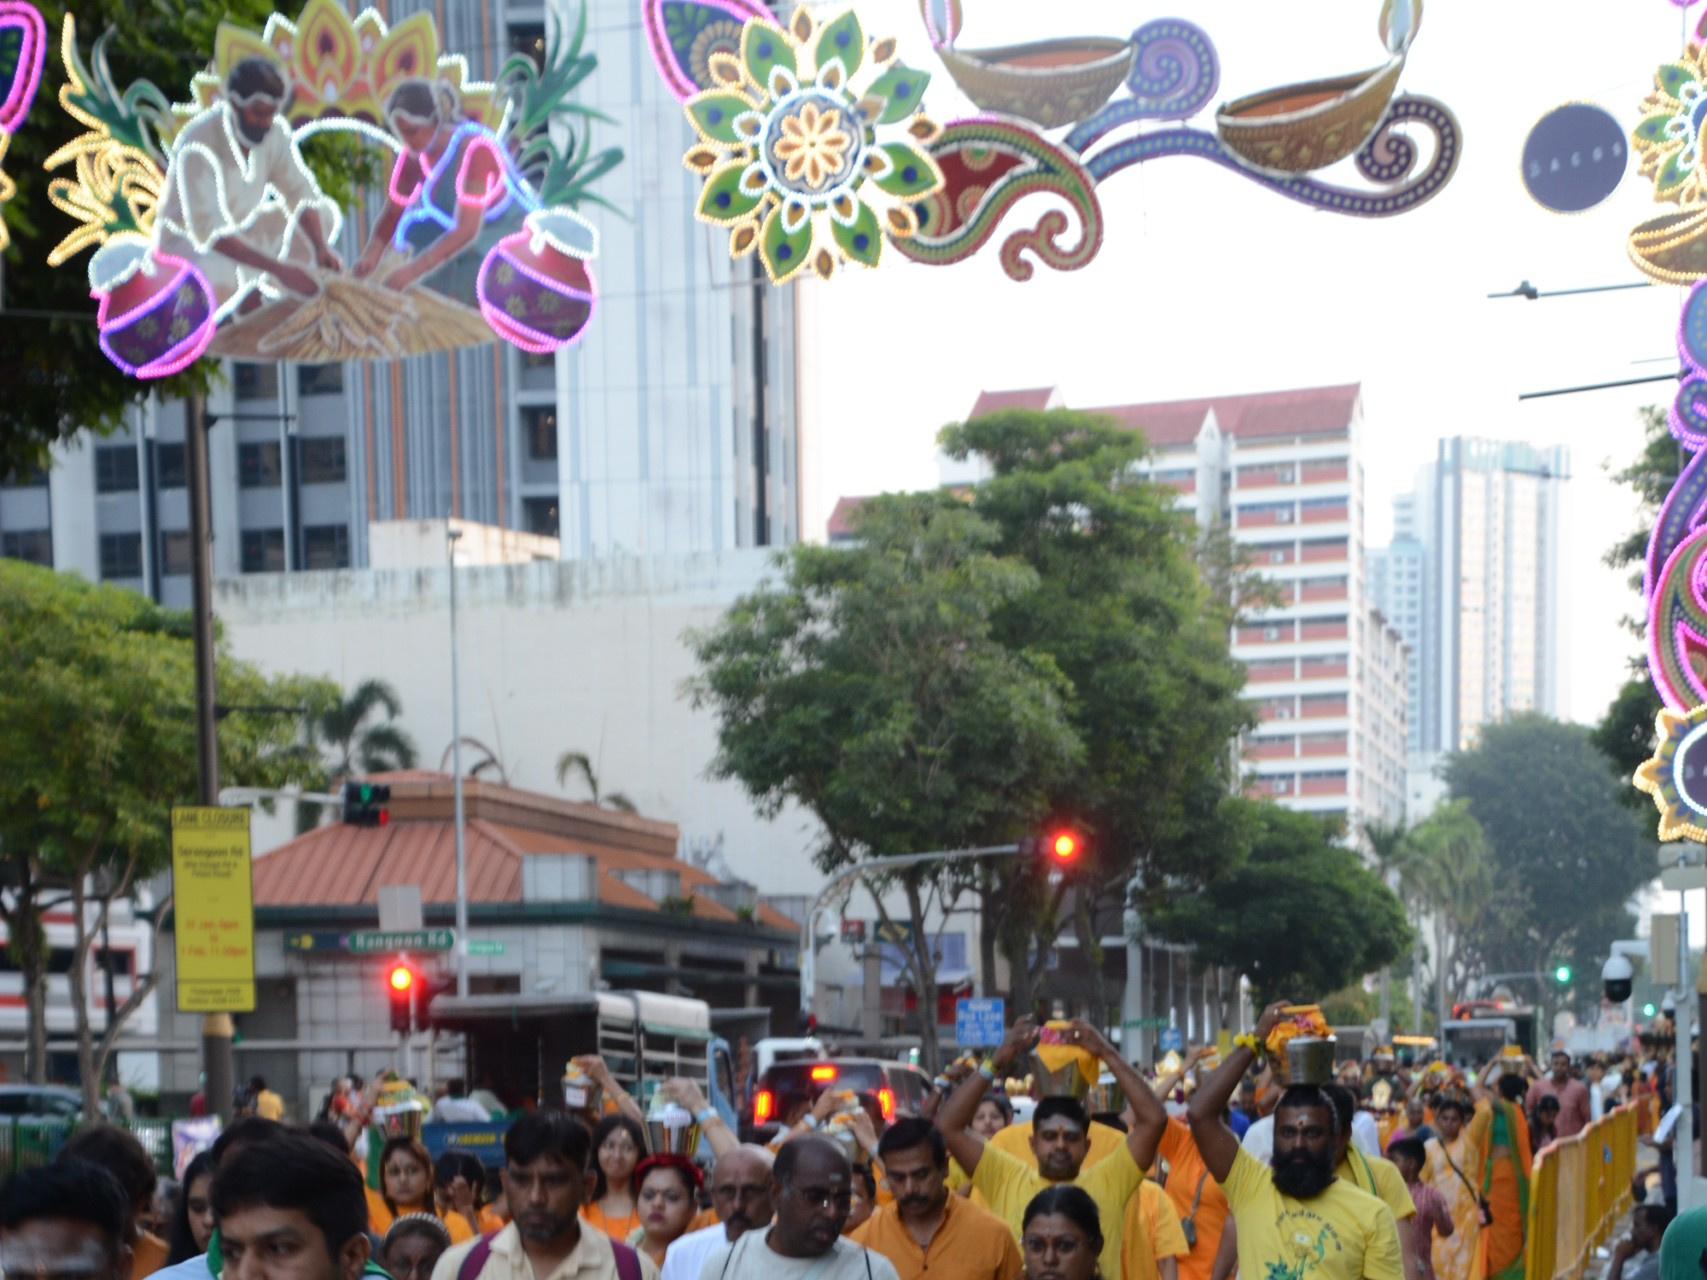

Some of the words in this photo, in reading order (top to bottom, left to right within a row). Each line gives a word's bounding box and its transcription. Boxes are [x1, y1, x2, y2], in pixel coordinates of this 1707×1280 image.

[201, 810, 245, 824] CLOSURE
[355, 934, 422, 949] Rangoon
[428, 932, 447, 946] Rd
